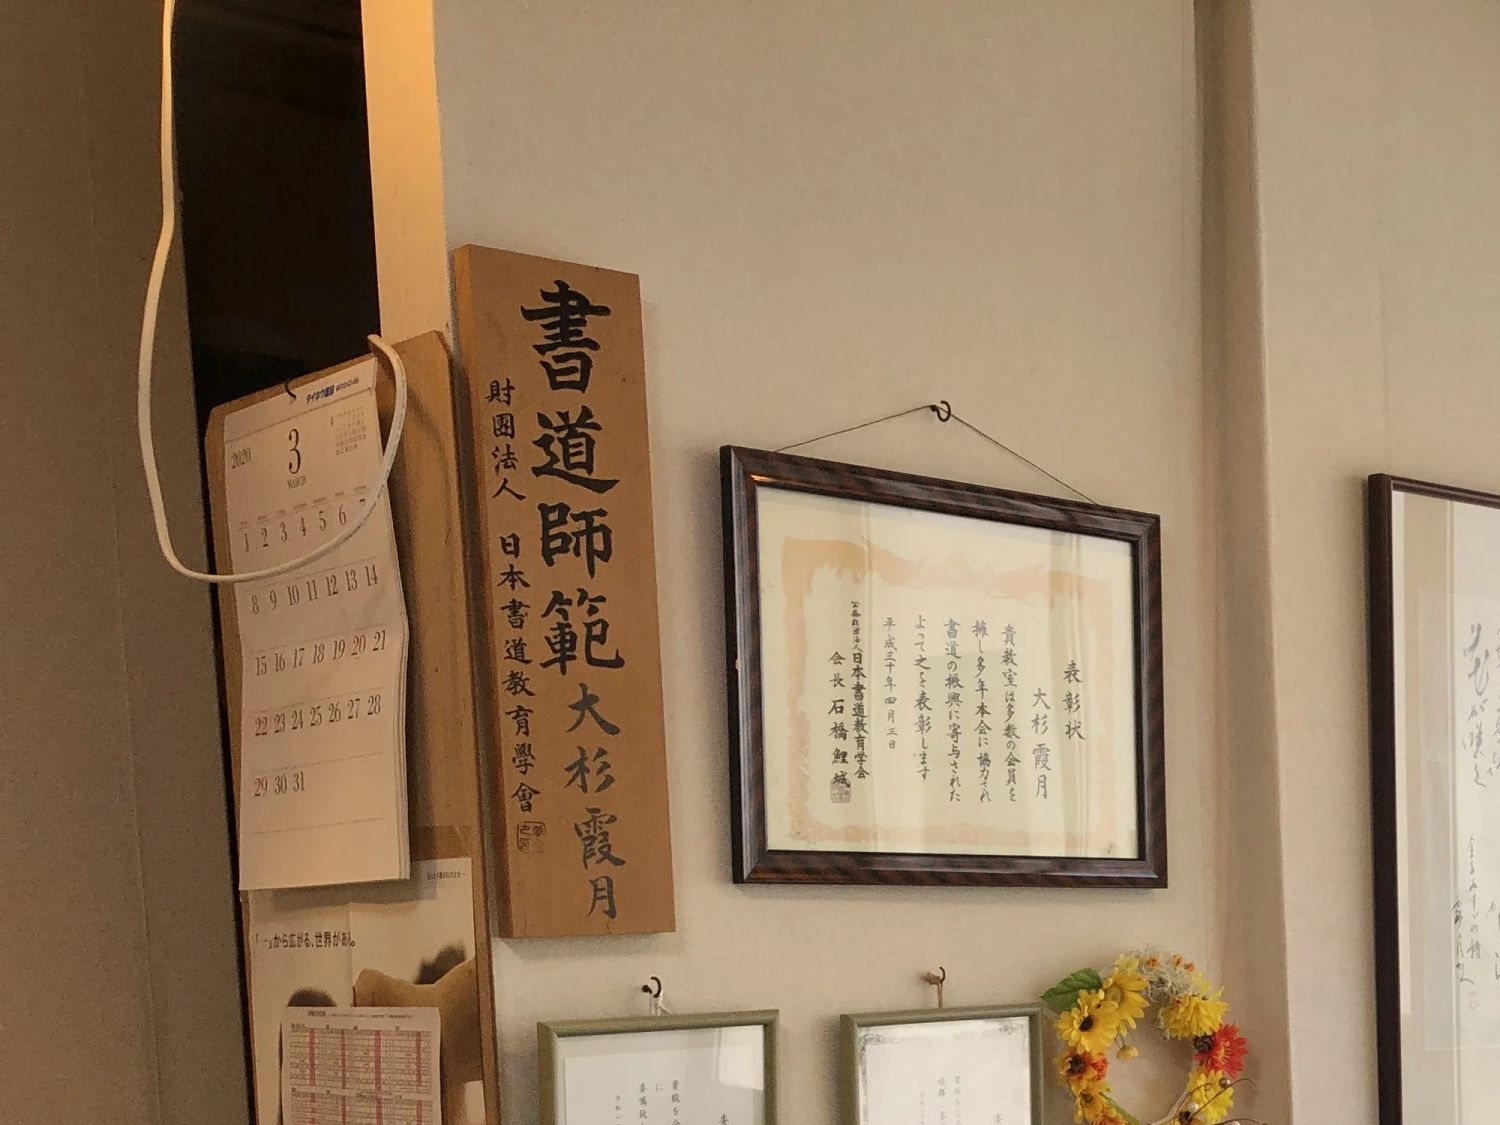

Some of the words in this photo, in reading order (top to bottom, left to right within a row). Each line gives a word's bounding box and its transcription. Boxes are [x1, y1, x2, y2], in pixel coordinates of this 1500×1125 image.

[231, 447, 252, 469] 2020
[287, 428, 302, 475] 3
[521, 279, 625, 676] 書道師範
[243, 532, 250, 553] 1
[261, 527, 269, 548] 2
[279, 521, 288, 543] 3
[299, 516, 307, 537] 4
[318, 509, 327, 532] 5
[338, 503, 347, 526] 6
[251, 594, 260, 615] 8
[269, 590, 278, 611] 9
[286, 584, 300, 606] 10
[306, 579, 319, 601] 11
[325, 574, 339, 597] 12
[345, 569, 358, 591] 13
[364, 563, 379, 587] 14
[255, 655, 268, 676] 15
[274, 652, 286, 672] 16
[292, 647, 305, 668] 17
[312, 643, 325, 664] 18
[332, 638, 346, 660] 19
[351, 634, 366, 657] 20
[372, 630, 387, 651] 21
[254, 716, 268, 737] 22
[274, 713, 286, 734] 23
[291, 709, 304, 730] 24
[309, 705, 322, 727] 25
[328, 702, 341, 723] 26
[347, 698, 361, 719] 27
[367, 694, 382, 716] 28
[1062, 659, 1086, 741] 表彰状
[1031, 687, 1052, 800] 大杉霞月
[254, 776, 268, 797] 29
[274, 773, 287, 795] 30
[292, 771, 305, 793] 31
[564, 682, 626, 920] 大杉霞月
